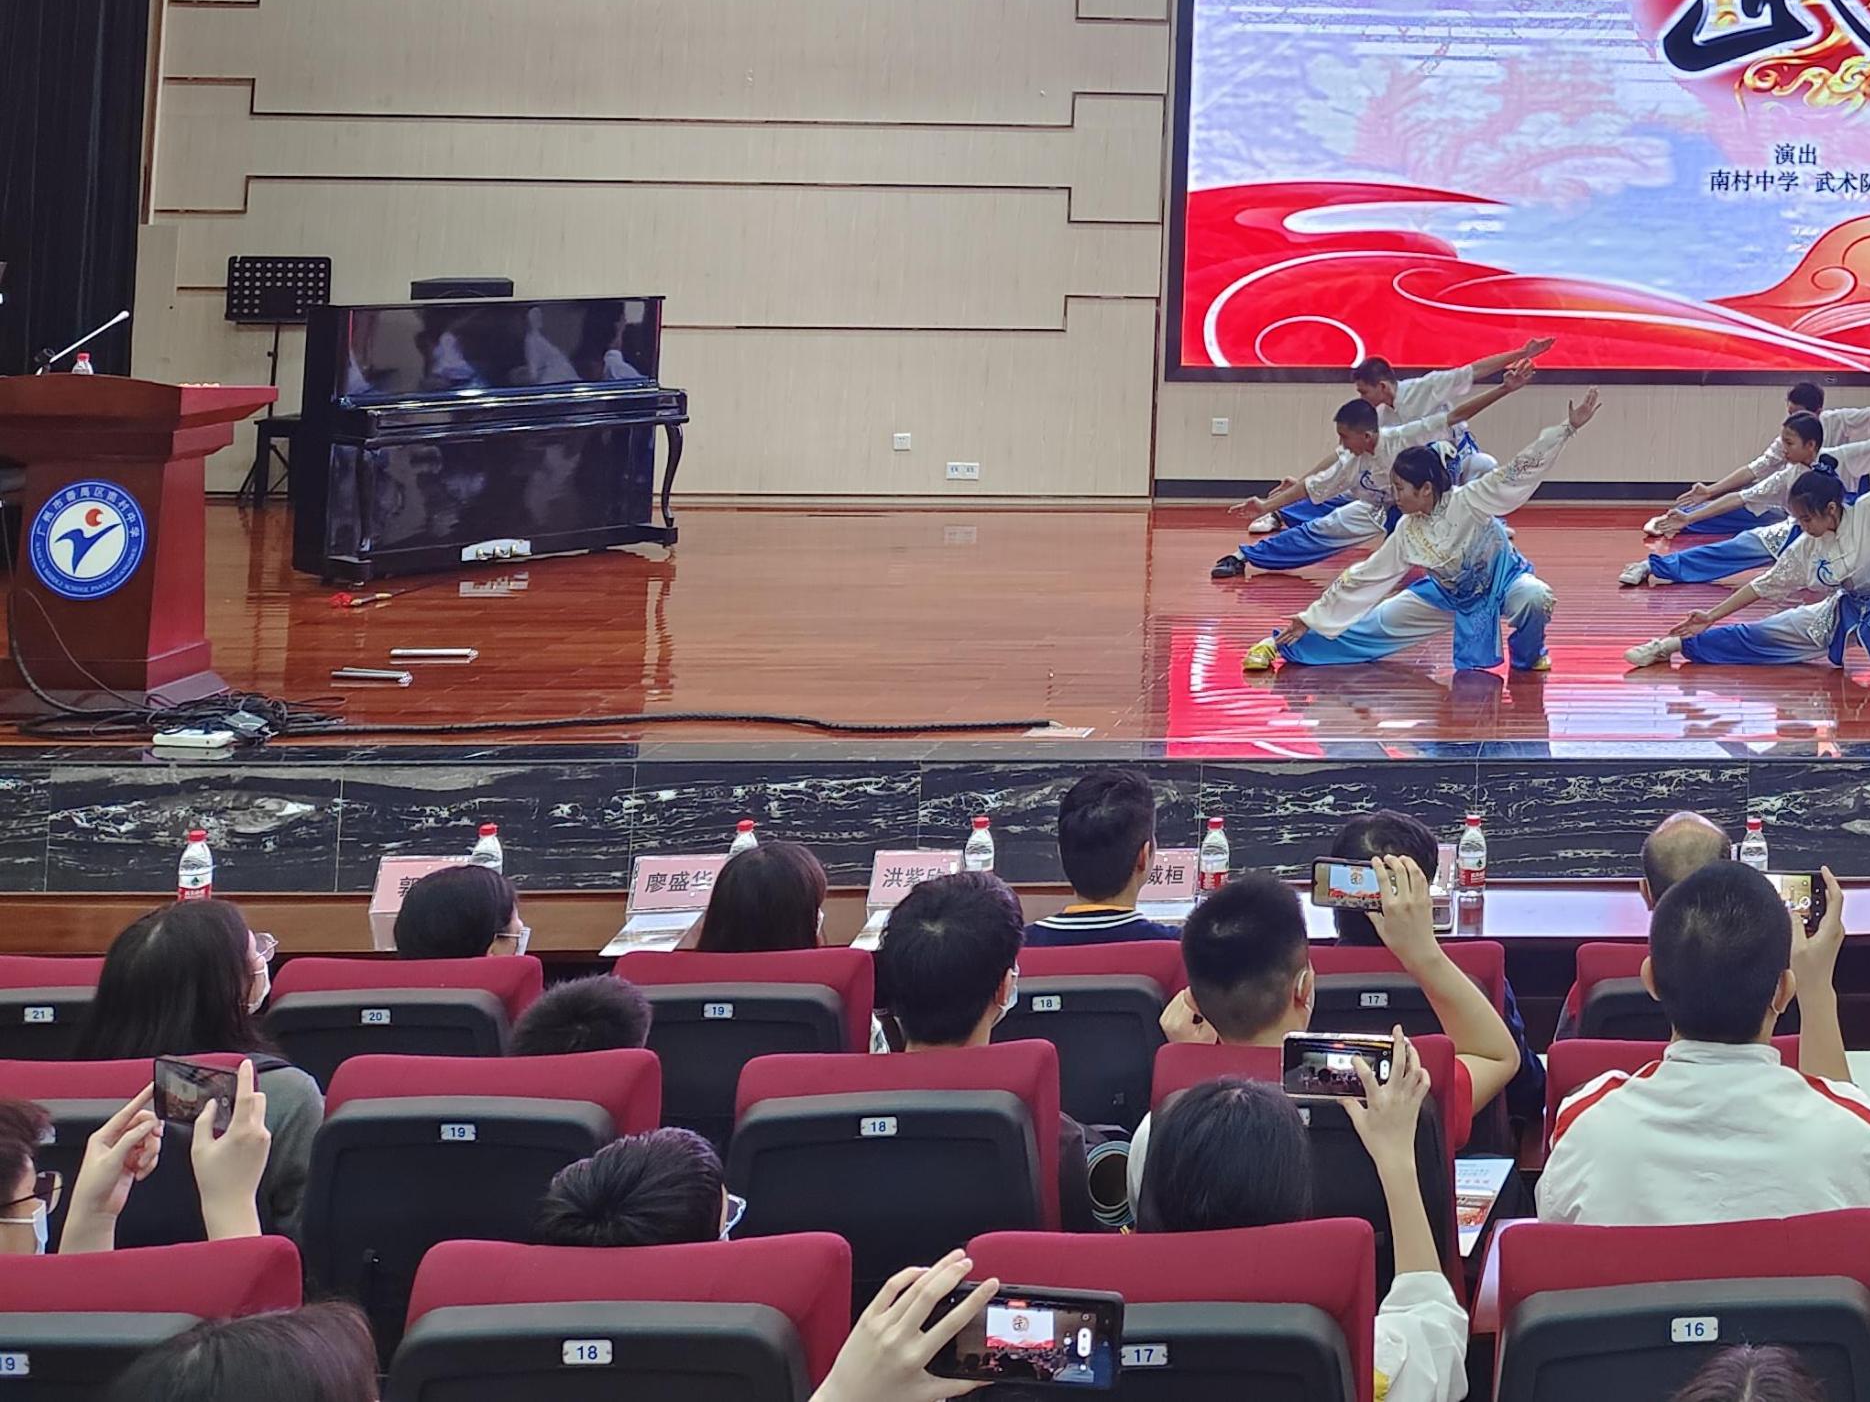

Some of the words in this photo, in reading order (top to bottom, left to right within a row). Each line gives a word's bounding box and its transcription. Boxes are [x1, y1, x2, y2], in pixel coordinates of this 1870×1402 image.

[1775, 143, 1817, 166] 演出
[1710, 170, 1799, 192] 南村中学
[645, 870, 713, 893] 廖盛华
[1040, 998, 1053, 1009] 18
[1368, 995, 1380, 1005] 17
[32, 1010, 45, 1020] 21
[369, 1011, 383, 1021] 20
[712, 1006, 725, 1016] 19
[870, 1121, 887, 1132] 18
[450, 1127, 466, 1138] 19
[1684, 1321, 1705, 1337] 16
[576, 1345, 598, 1361] 18
[1134, 1348, 1155, 1363] 17
